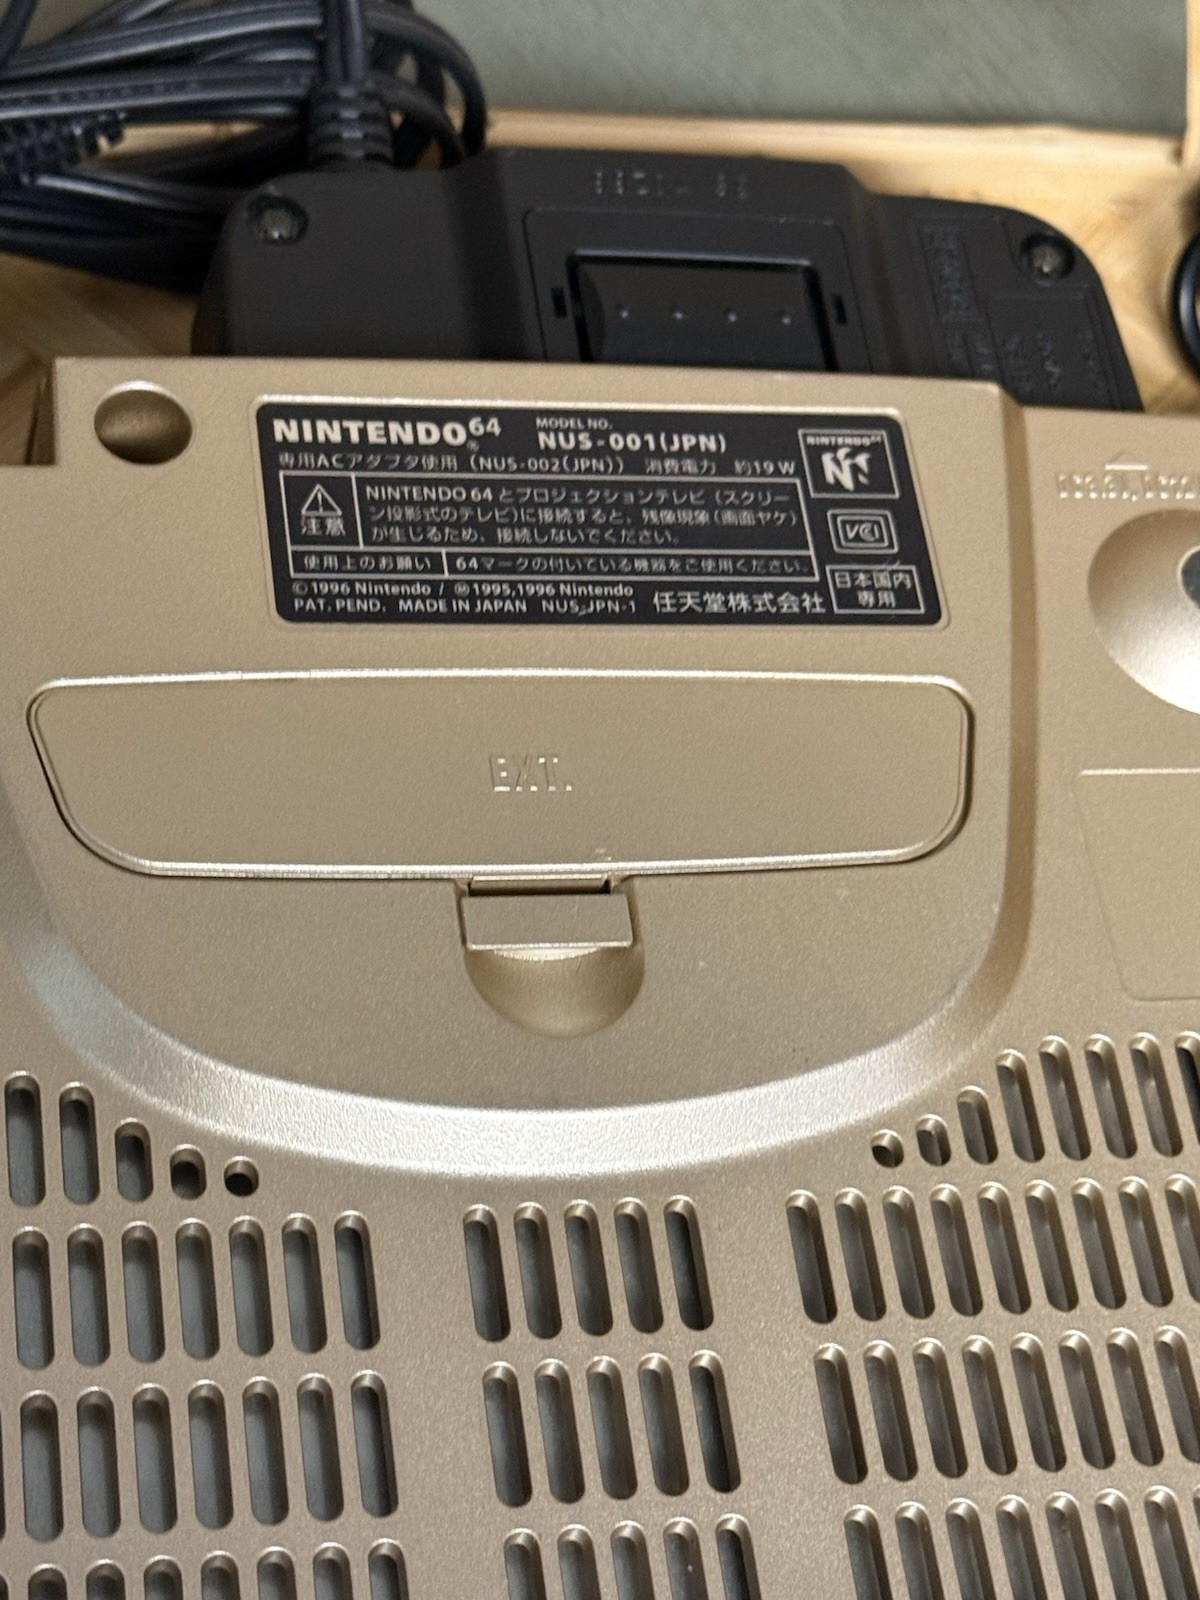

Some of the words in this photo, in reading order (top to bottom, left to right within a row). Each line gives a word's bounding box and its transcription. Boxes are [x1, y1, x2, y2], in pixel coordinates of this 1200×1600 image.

[536, 416, 586, 429] MODEL
[588, 418, 613, 431] NO.
[537, 431, 727, 452] NUS-001(JPN)
[355, 582, 432, 597] Nintendo
[560, 583, 633, 597] Nintendo
[834, 571, 912, 590] 日本国内
[399, 599, 448, 613] MADE
[452, 599, 470, 613] IN
[474, 599, 528, 613] JAPAN
[653, 591, 827, 614] 任天堂株式会社
[857, 590, 896, 608] 専用
[489, 754, 573, 792] EXT.
